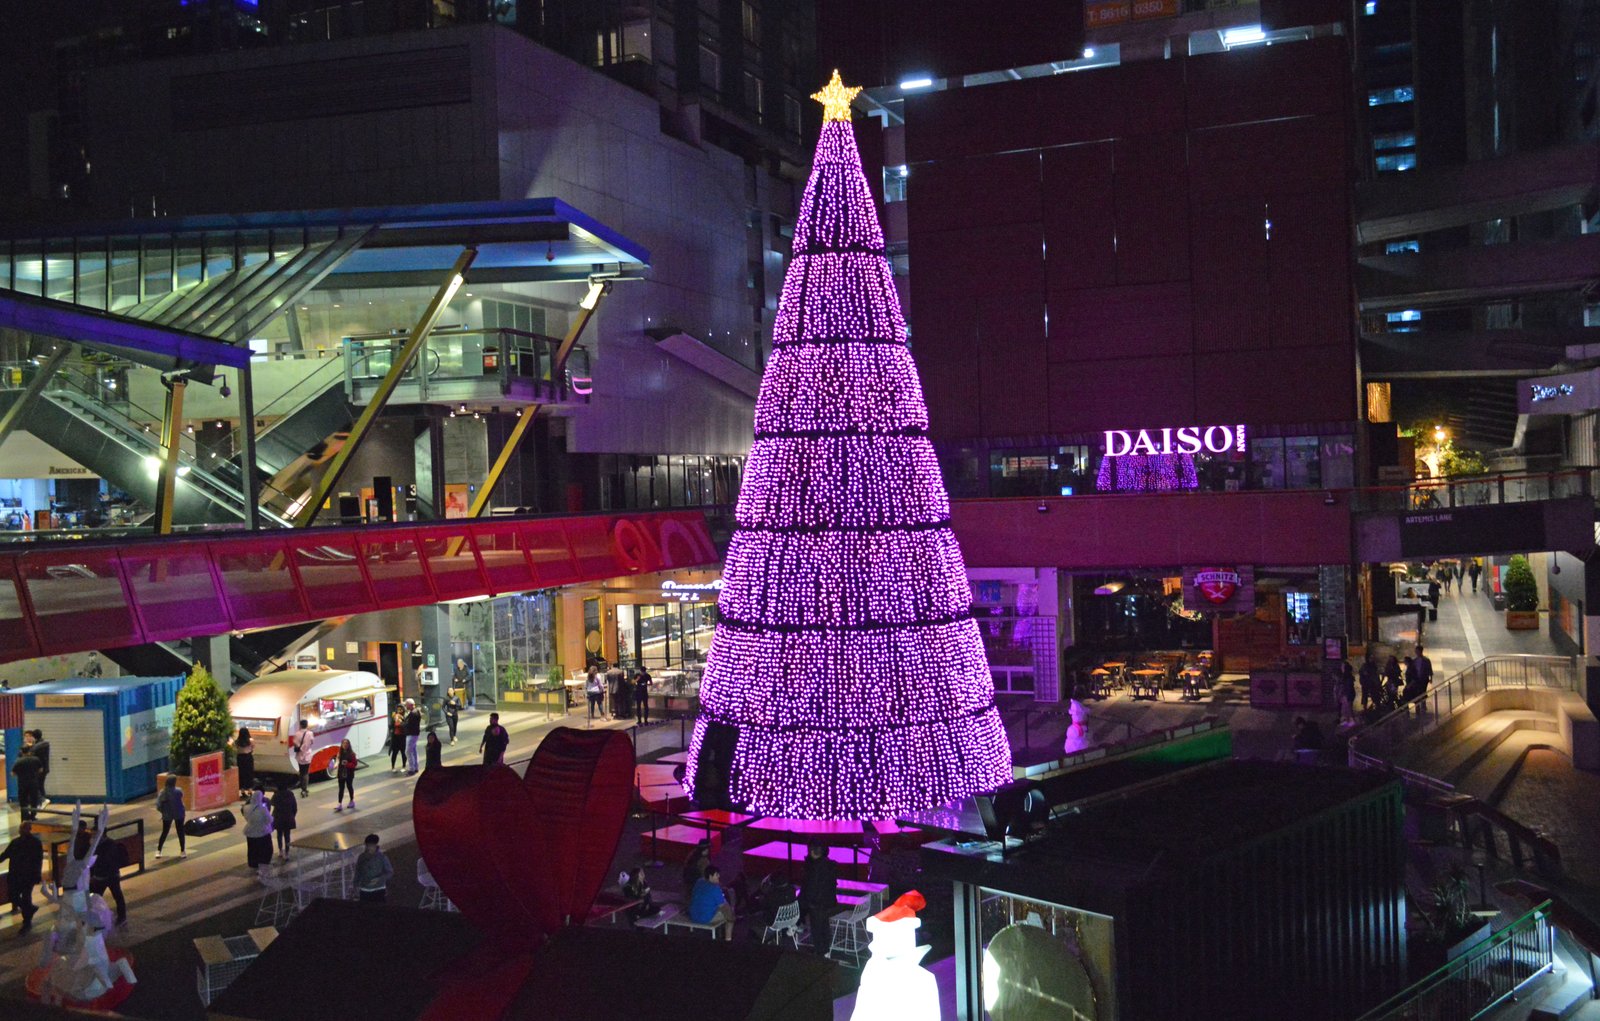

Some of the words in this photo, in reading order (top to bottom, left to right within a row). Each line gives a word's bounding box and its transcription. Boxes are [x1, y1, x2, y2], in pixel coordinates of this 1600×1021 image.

[1104, 426, 1233, 457] DAISO
[1237, 425, 1246, 452] JAPAN
[410, 484, 417, 496] 3
[1406, 515, 1434, 524] ARTEMIS
[1435, 513, 1453, 522] LANE
[1201, 573, 1234, 581] SCHNITZ
[415, 640, 423, 654] 2
